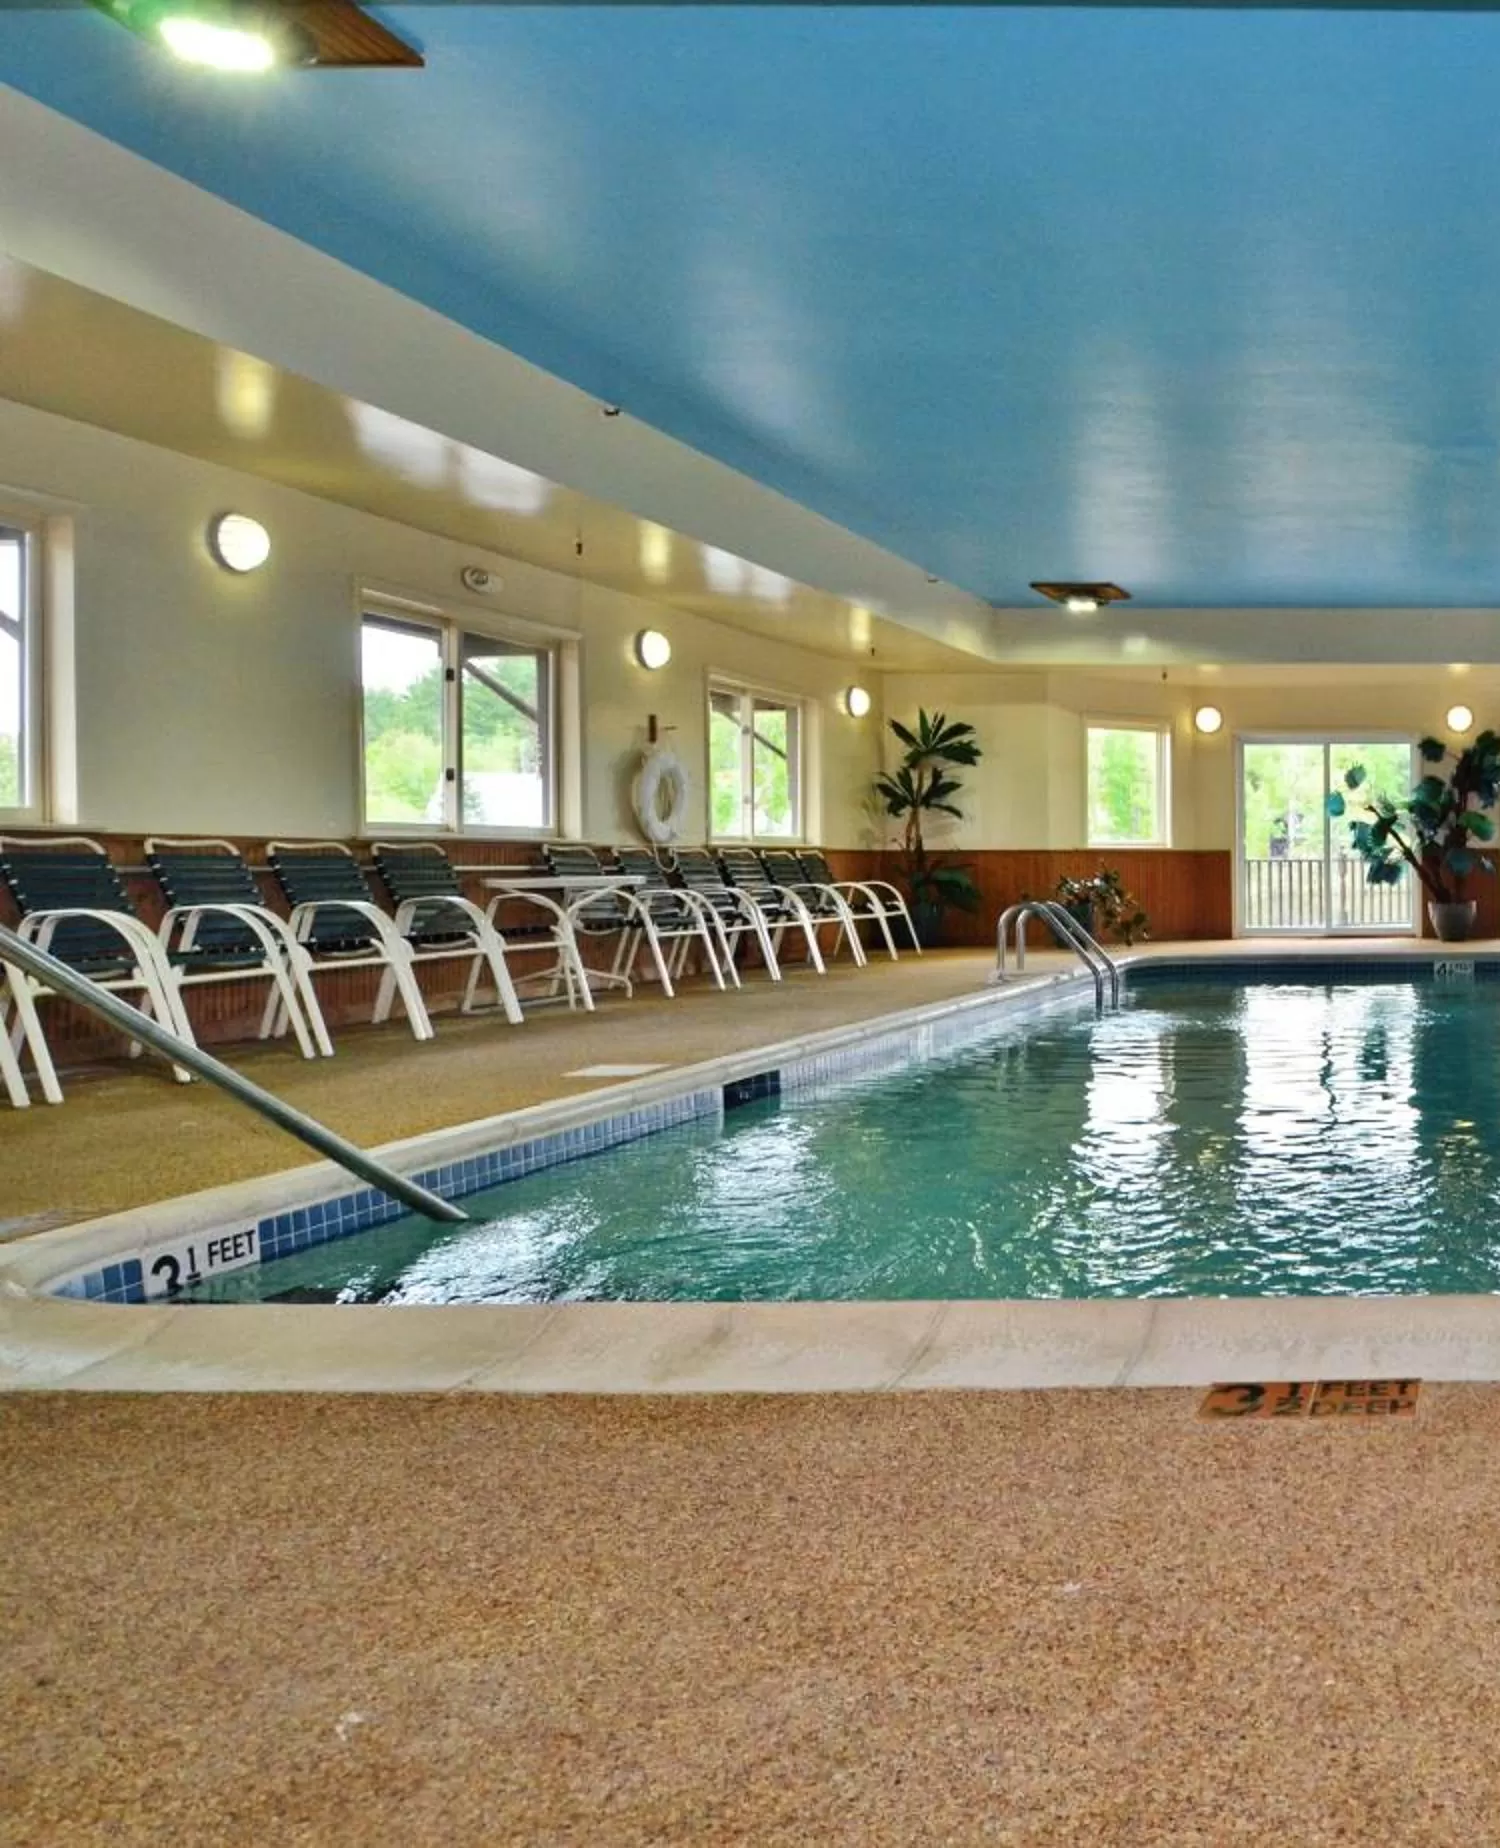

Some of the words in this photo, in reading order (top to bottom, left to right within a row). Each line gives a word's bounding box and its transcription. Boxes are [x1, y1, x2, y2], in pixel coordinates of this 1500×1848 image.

[207, 1229, 255, 1268] FEET
[1319, 1380, 1412, 1398] FEET
[1309, 1399, 1416, 1417] DEEP
